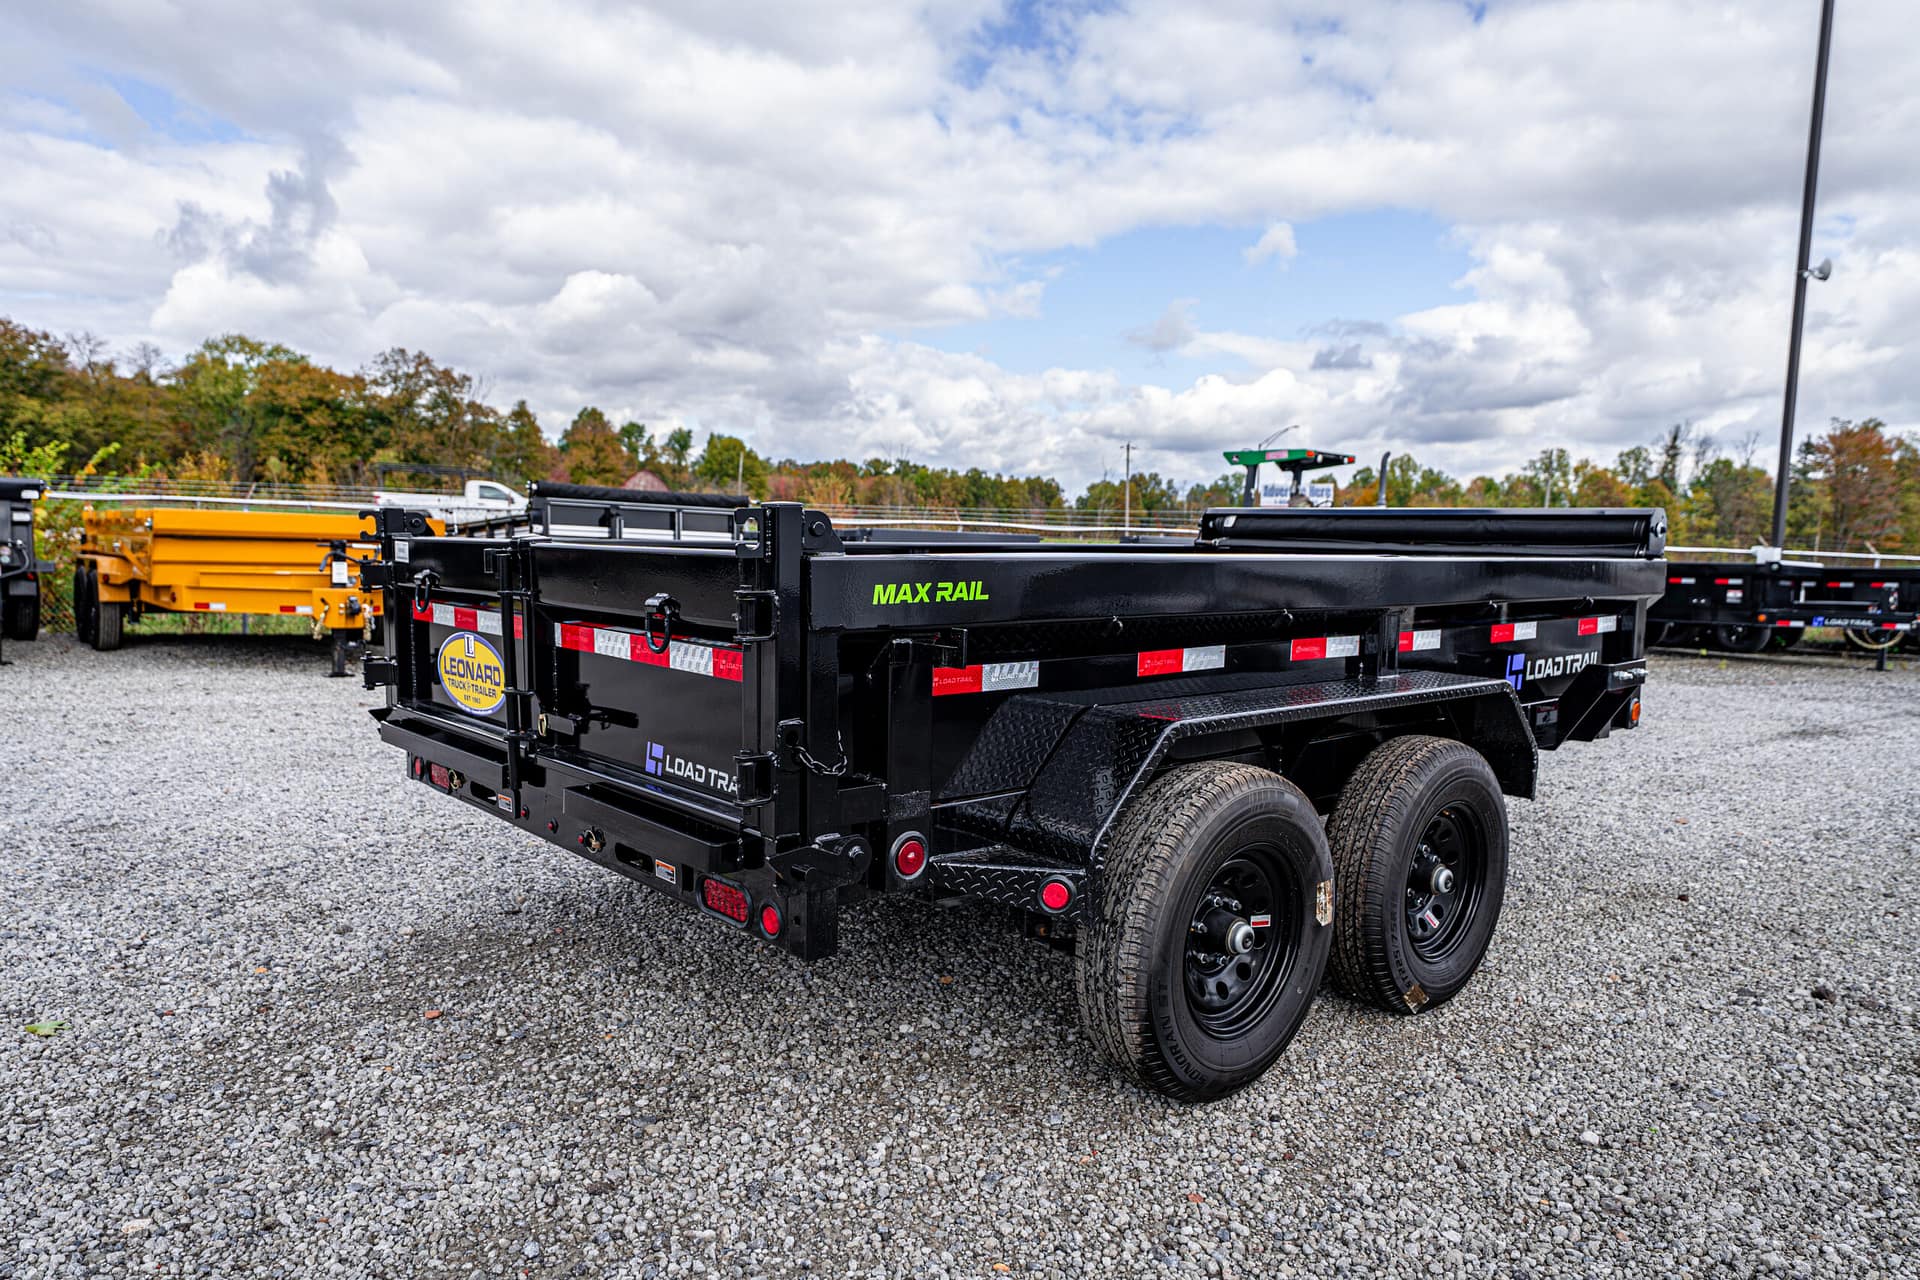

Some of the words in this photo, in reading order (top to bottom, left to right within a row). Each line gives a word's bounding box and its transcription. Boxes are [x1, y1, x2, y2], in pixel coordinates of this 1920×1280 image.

[872, 583, 932, 605] MAX
[935, 581, 989, 602] RAIL
[443, 656, 501, 687] LEONARD
[447, 677, 467, 691] TRUCK
[471, 683, 498, 699] TRAILER
[708, 768, 738, 795] TRA
[1160, 1015, 1208, 1085] SONORAN
